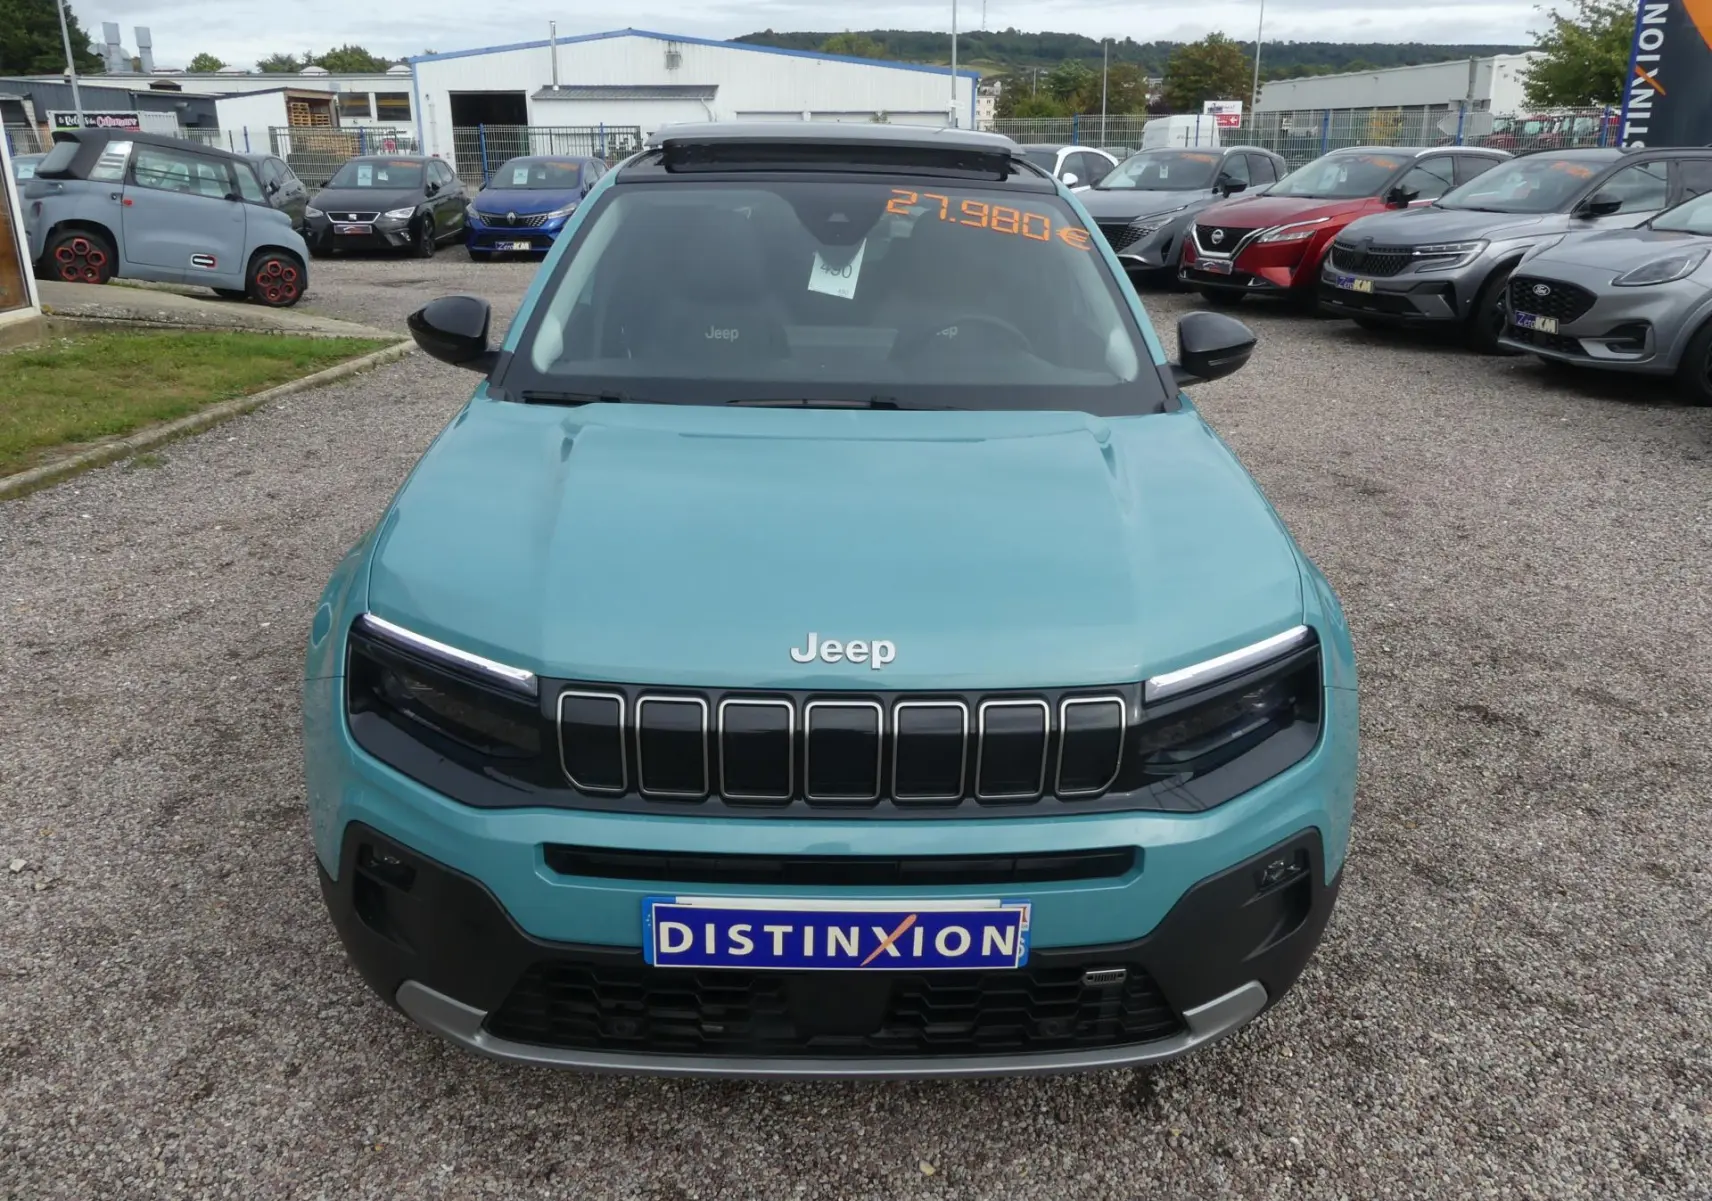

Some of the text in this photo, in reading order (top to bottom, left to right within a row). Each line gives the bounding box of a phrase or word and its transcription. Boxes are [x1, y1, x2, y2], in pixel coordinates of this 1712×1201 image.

[704, 325, 739, 342] Jeep
[789, 632, 896, 670] Jeep
[658, 913, 1016, 967] DISTINXION
